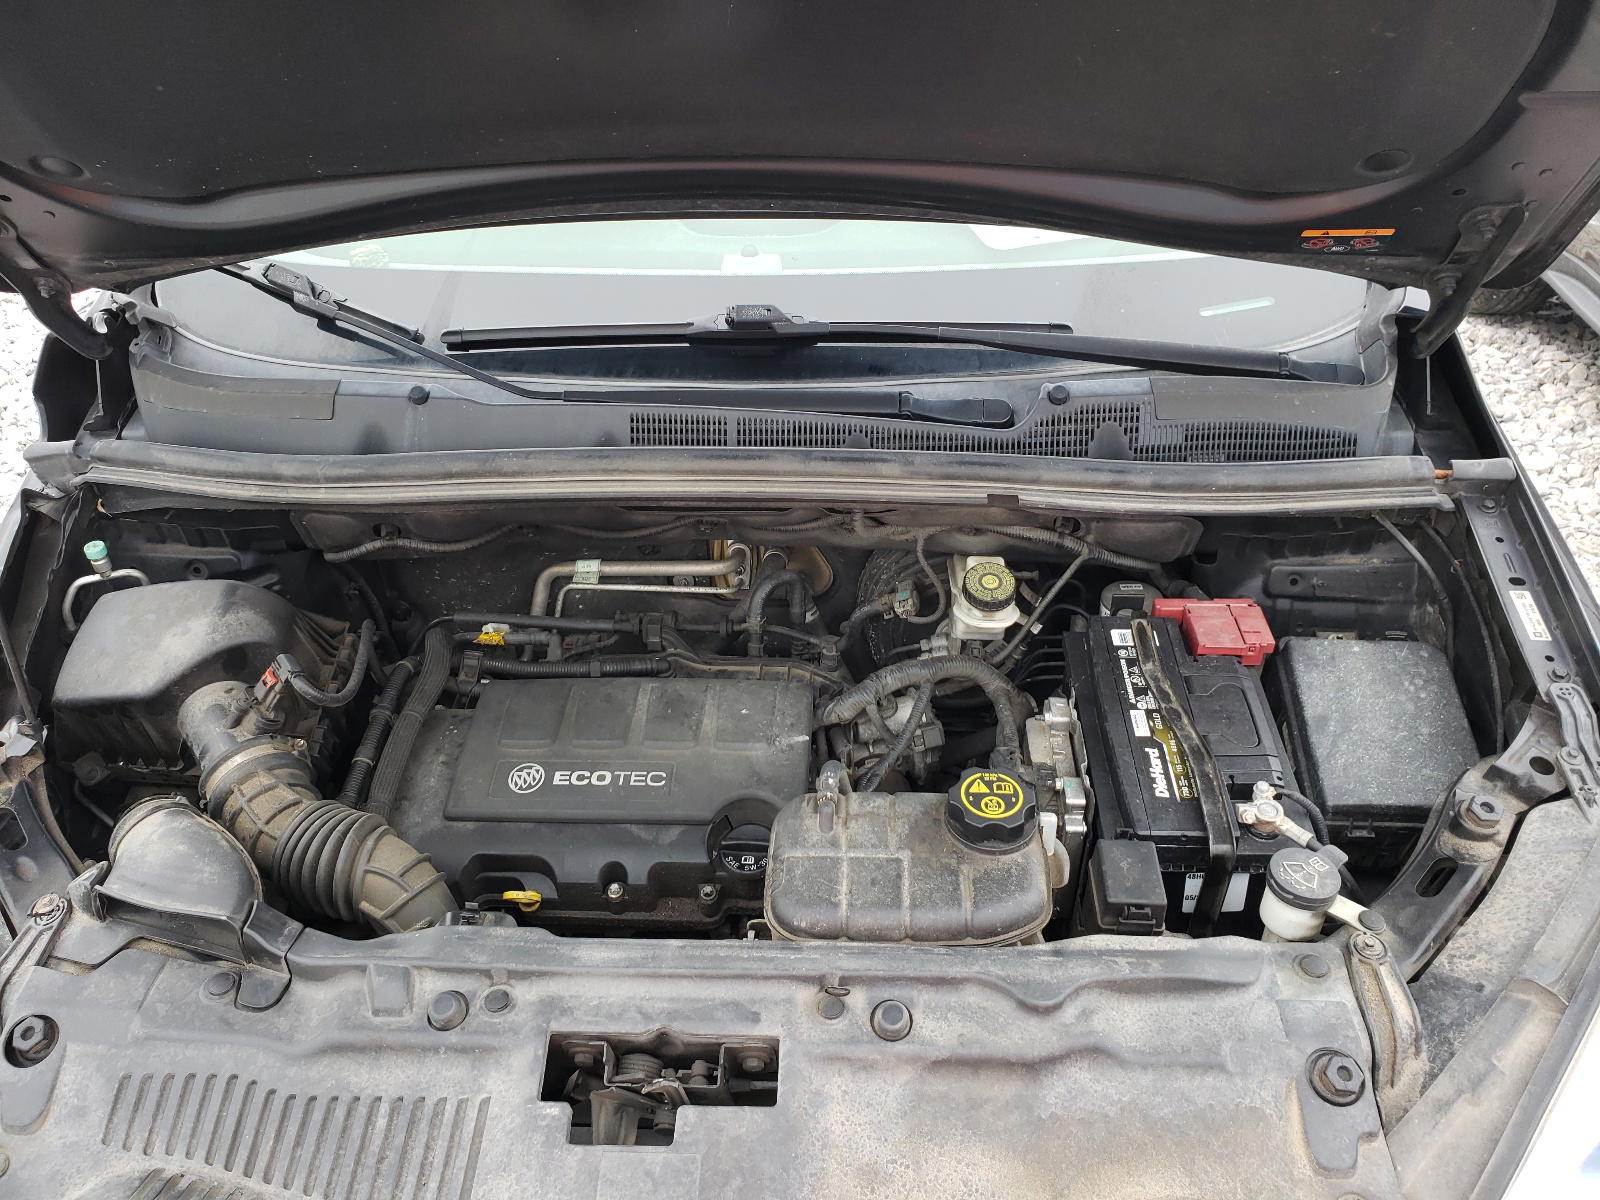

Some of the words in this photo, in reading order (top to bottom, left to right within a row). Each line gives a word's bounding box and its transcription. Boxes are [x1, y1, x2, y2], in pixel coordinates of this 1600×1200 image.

[1153, 712, 1163, 729] GOLD
[552, 770, 667, 786] ECOTEC
[1144, 747, 1170, 798] DieHard
[725, 856, 740, 869] SAE
[744, 857, 769, 871] 5W-30
